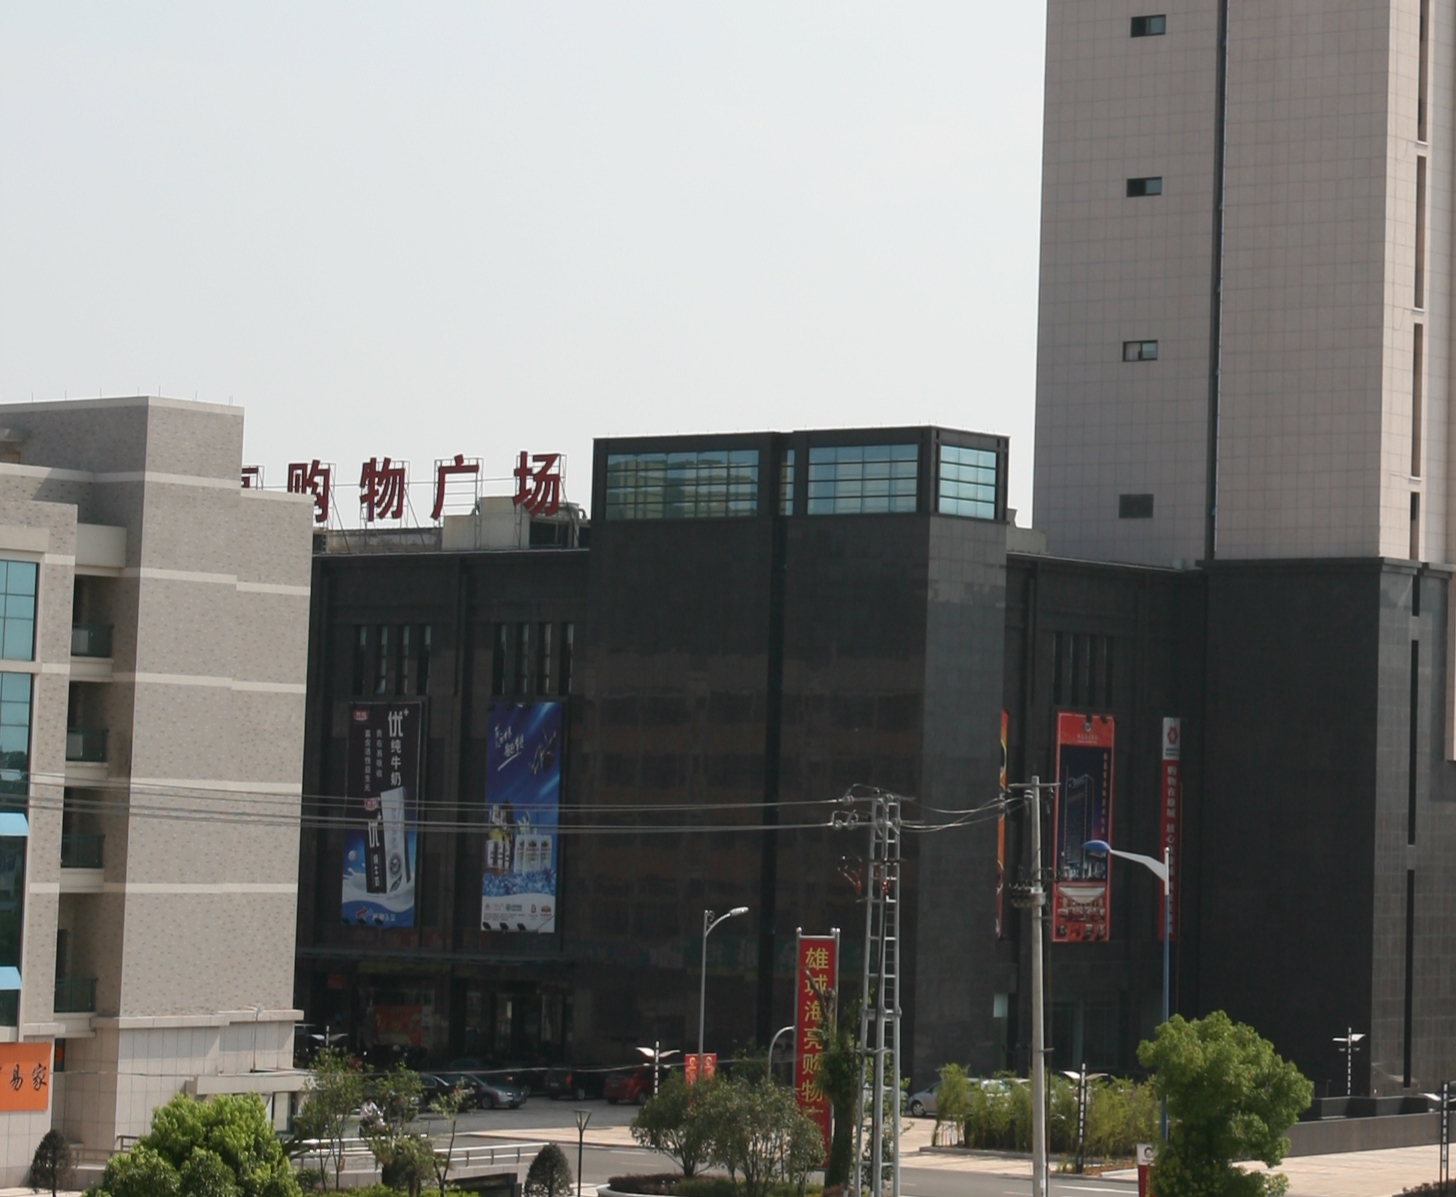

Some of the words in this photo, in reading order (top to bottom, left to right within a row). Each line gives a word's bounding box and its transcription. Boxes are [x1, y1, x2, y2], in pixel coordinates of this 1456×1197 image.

[241, 451, 562, 523] 购物广场
[0, 1062, 48, 1092] 易家
